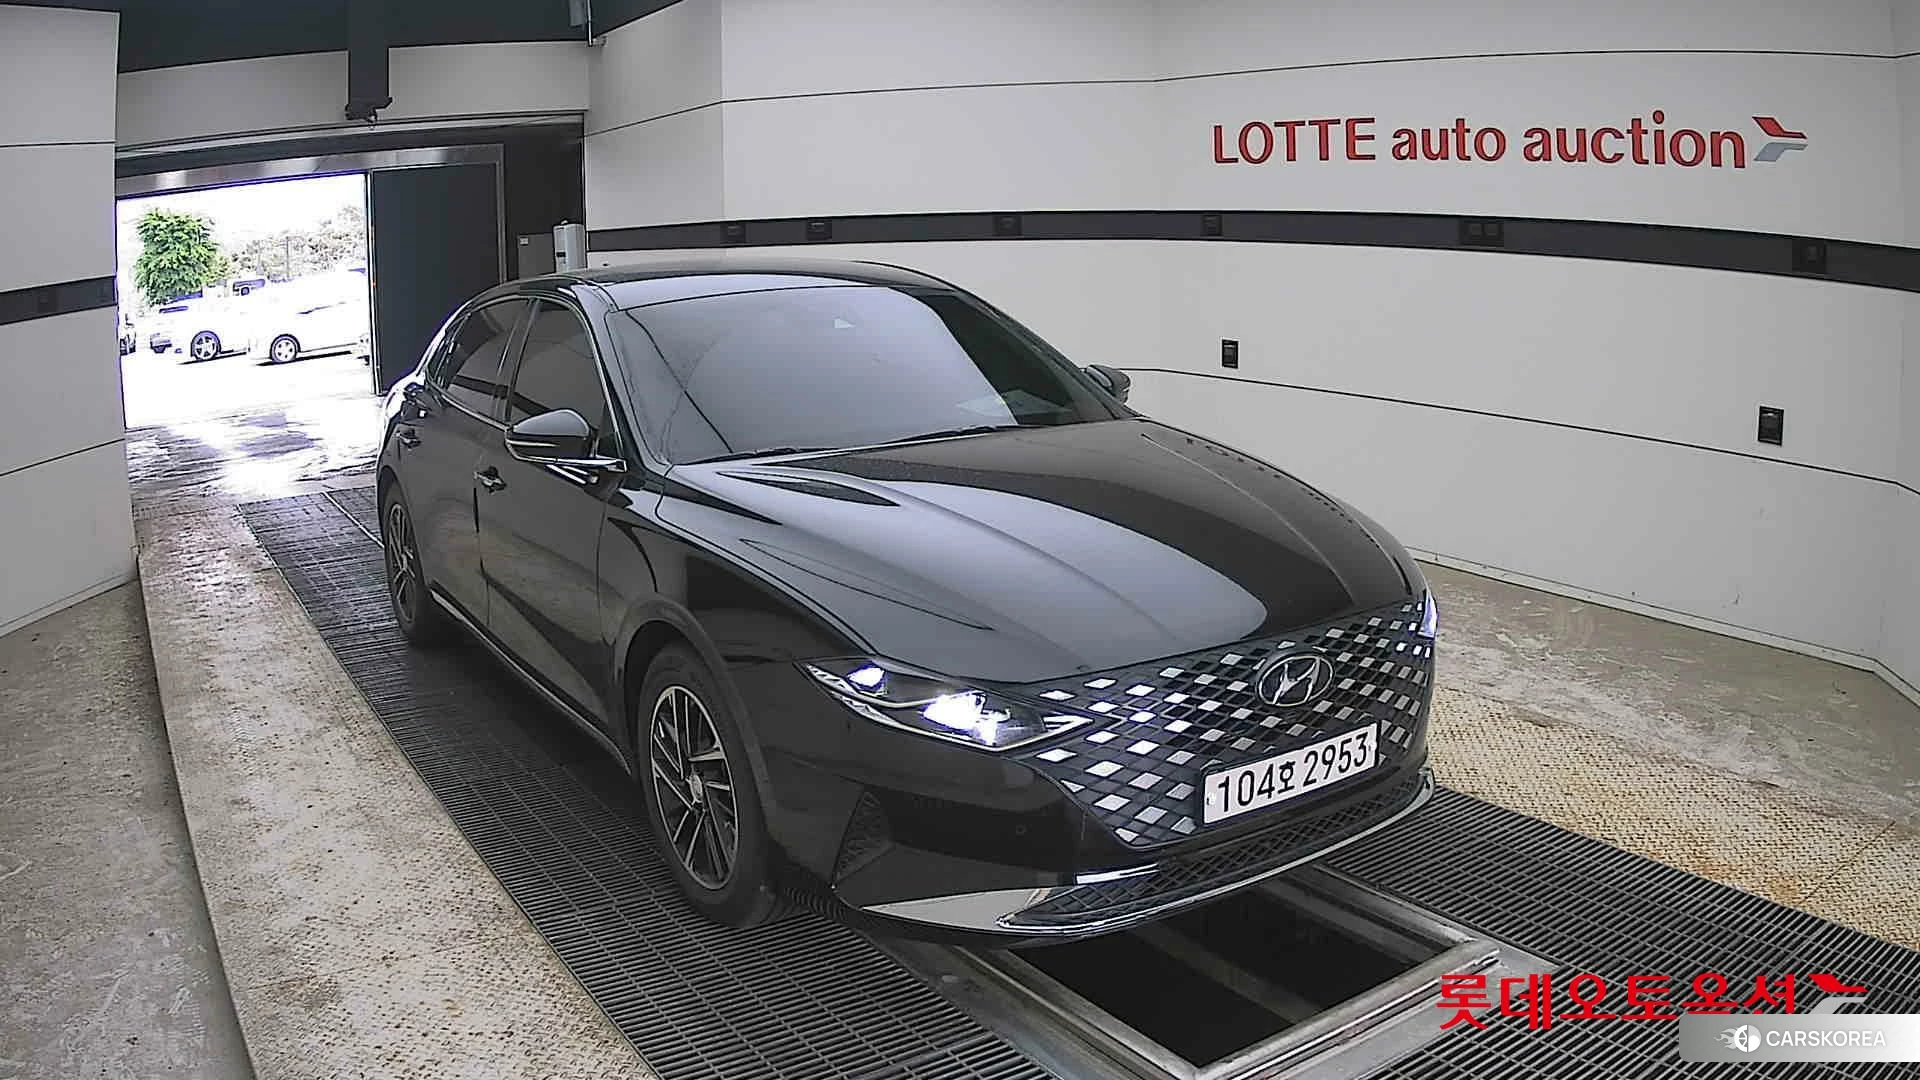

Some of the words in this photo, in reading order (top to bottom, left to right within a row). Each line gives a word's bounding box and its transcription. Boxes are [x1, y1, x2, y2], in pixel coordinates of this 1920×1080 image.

[1213, 117, 1376, 163] LOTTE
[1392, 118, 1507, 162] auto
[1523, 110, 1747, 169] auction
[1303, 732, 1369, 787] 2953
